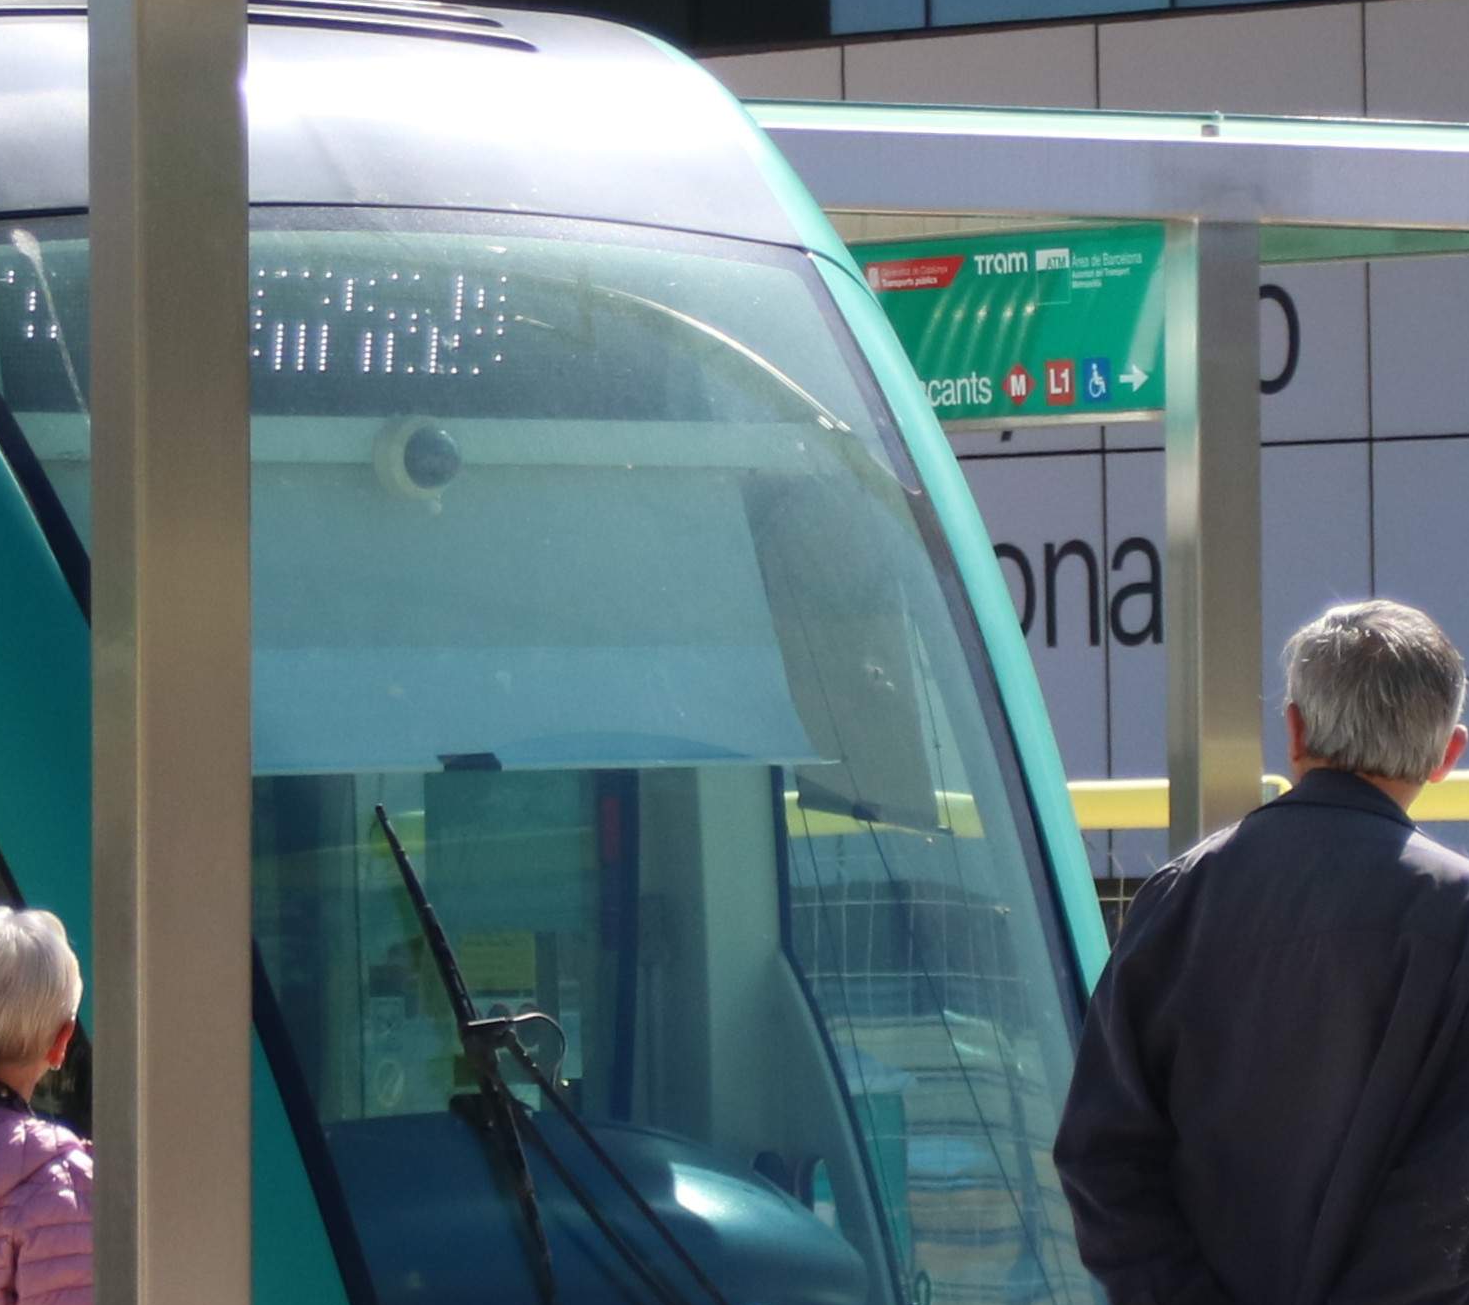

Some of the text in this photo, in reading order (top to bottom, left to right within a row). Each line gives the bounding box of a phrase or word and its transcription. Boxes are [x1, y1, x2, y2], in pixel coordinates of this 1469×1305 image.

[974, 252, 1028, 275] Tram
[1011, 375, 1026, 397] M
[1049, 368, 1071, 395] L1
